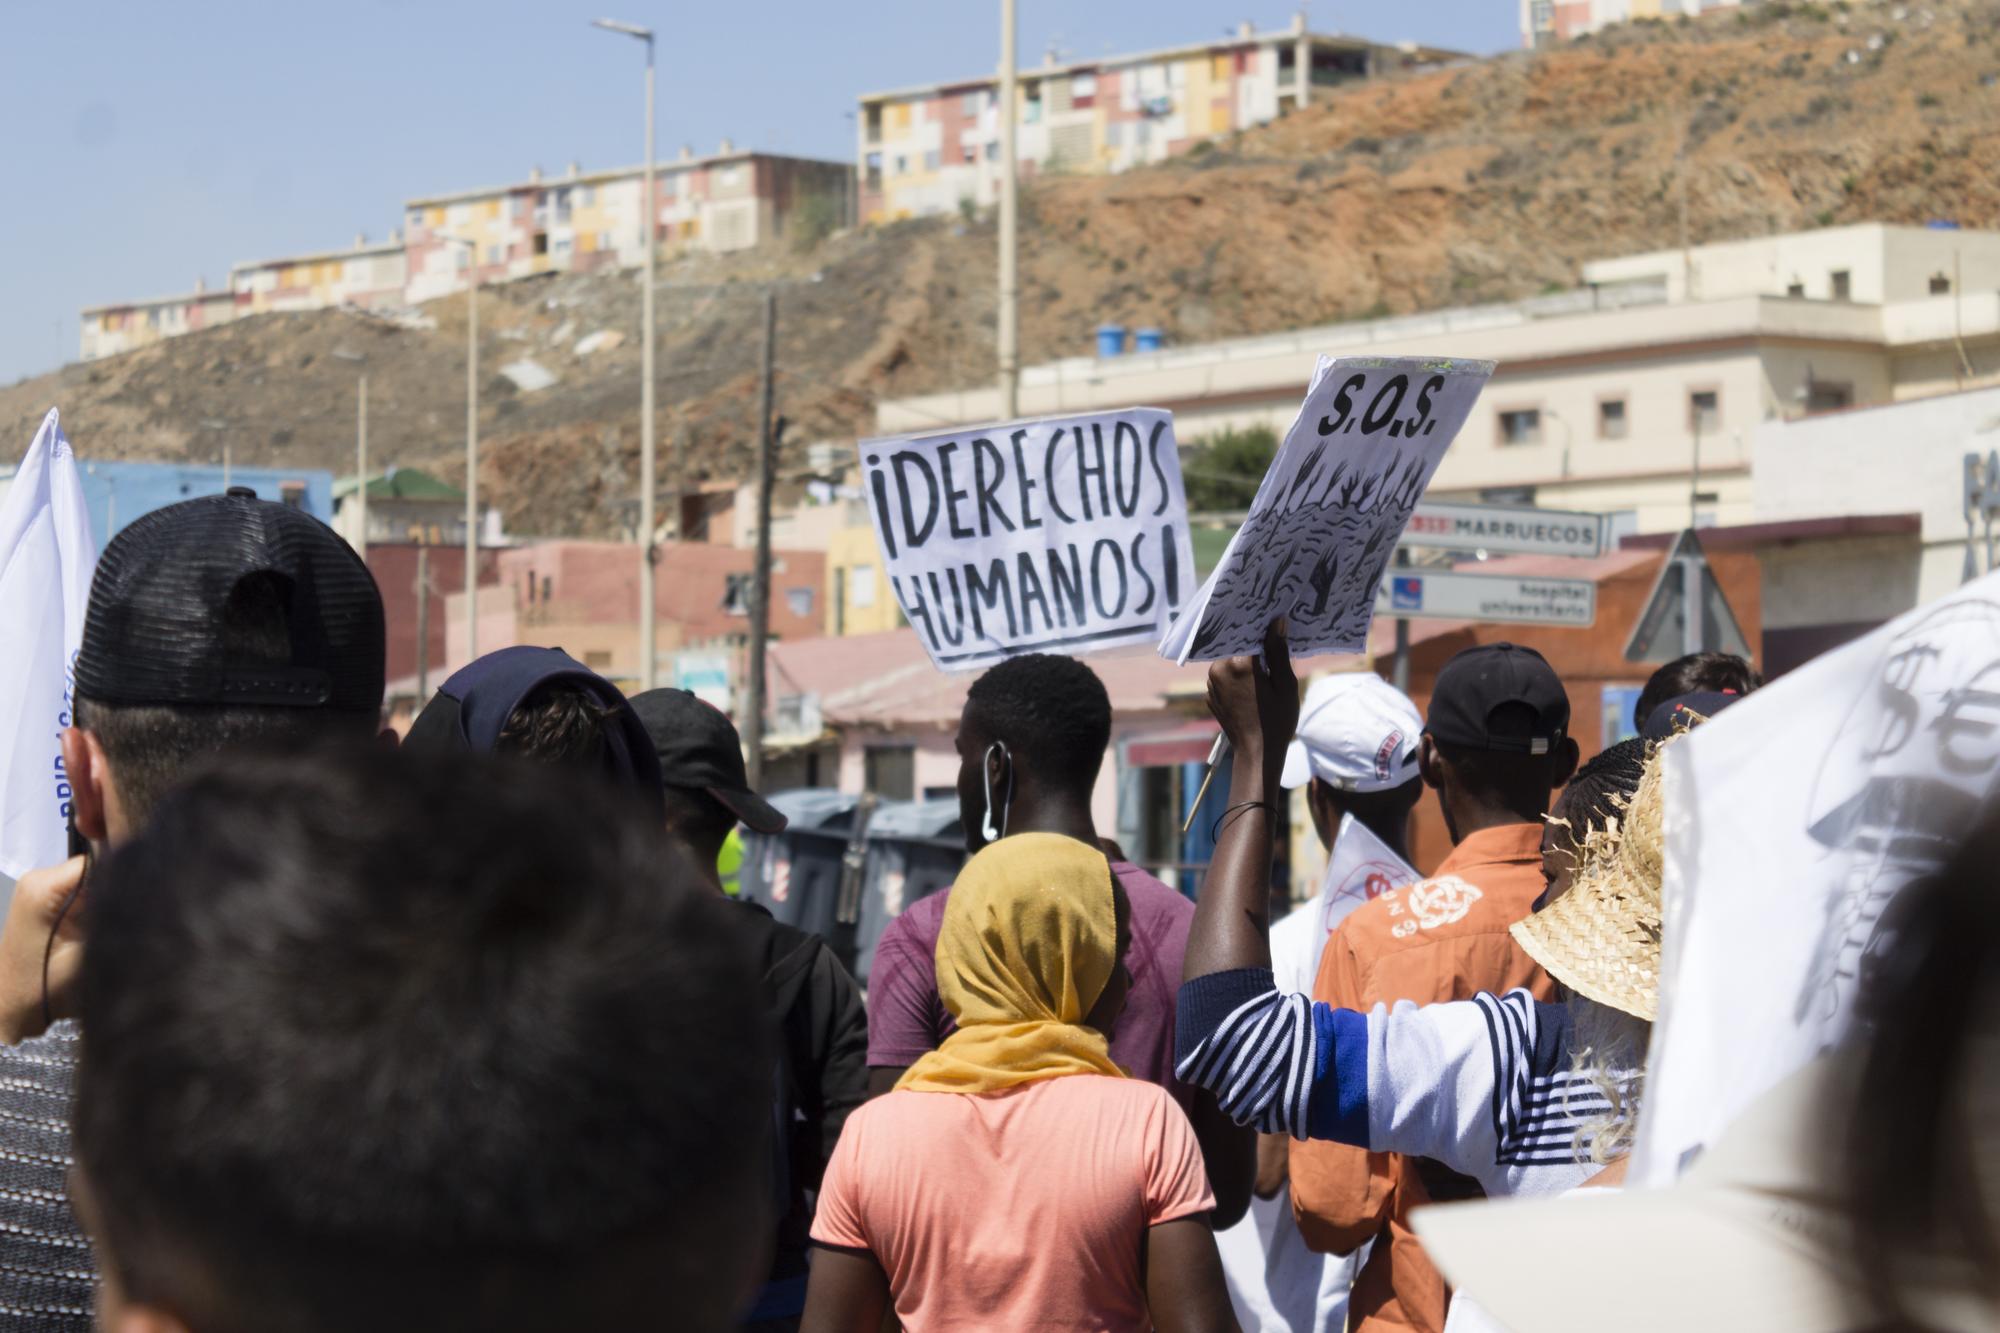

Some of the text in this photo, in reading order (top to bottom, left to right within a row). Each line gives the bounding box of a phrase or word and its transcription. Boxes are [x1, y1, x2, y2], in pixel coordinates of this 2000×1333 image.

[1317, 373, 1446, 438] S.O.S.
[866, 420, 1168, 560] ¡DERECHOS
[1454, 518, 1594, 545] MARRUECOS
[891, 524, 1180, 651] HUMANOS!
